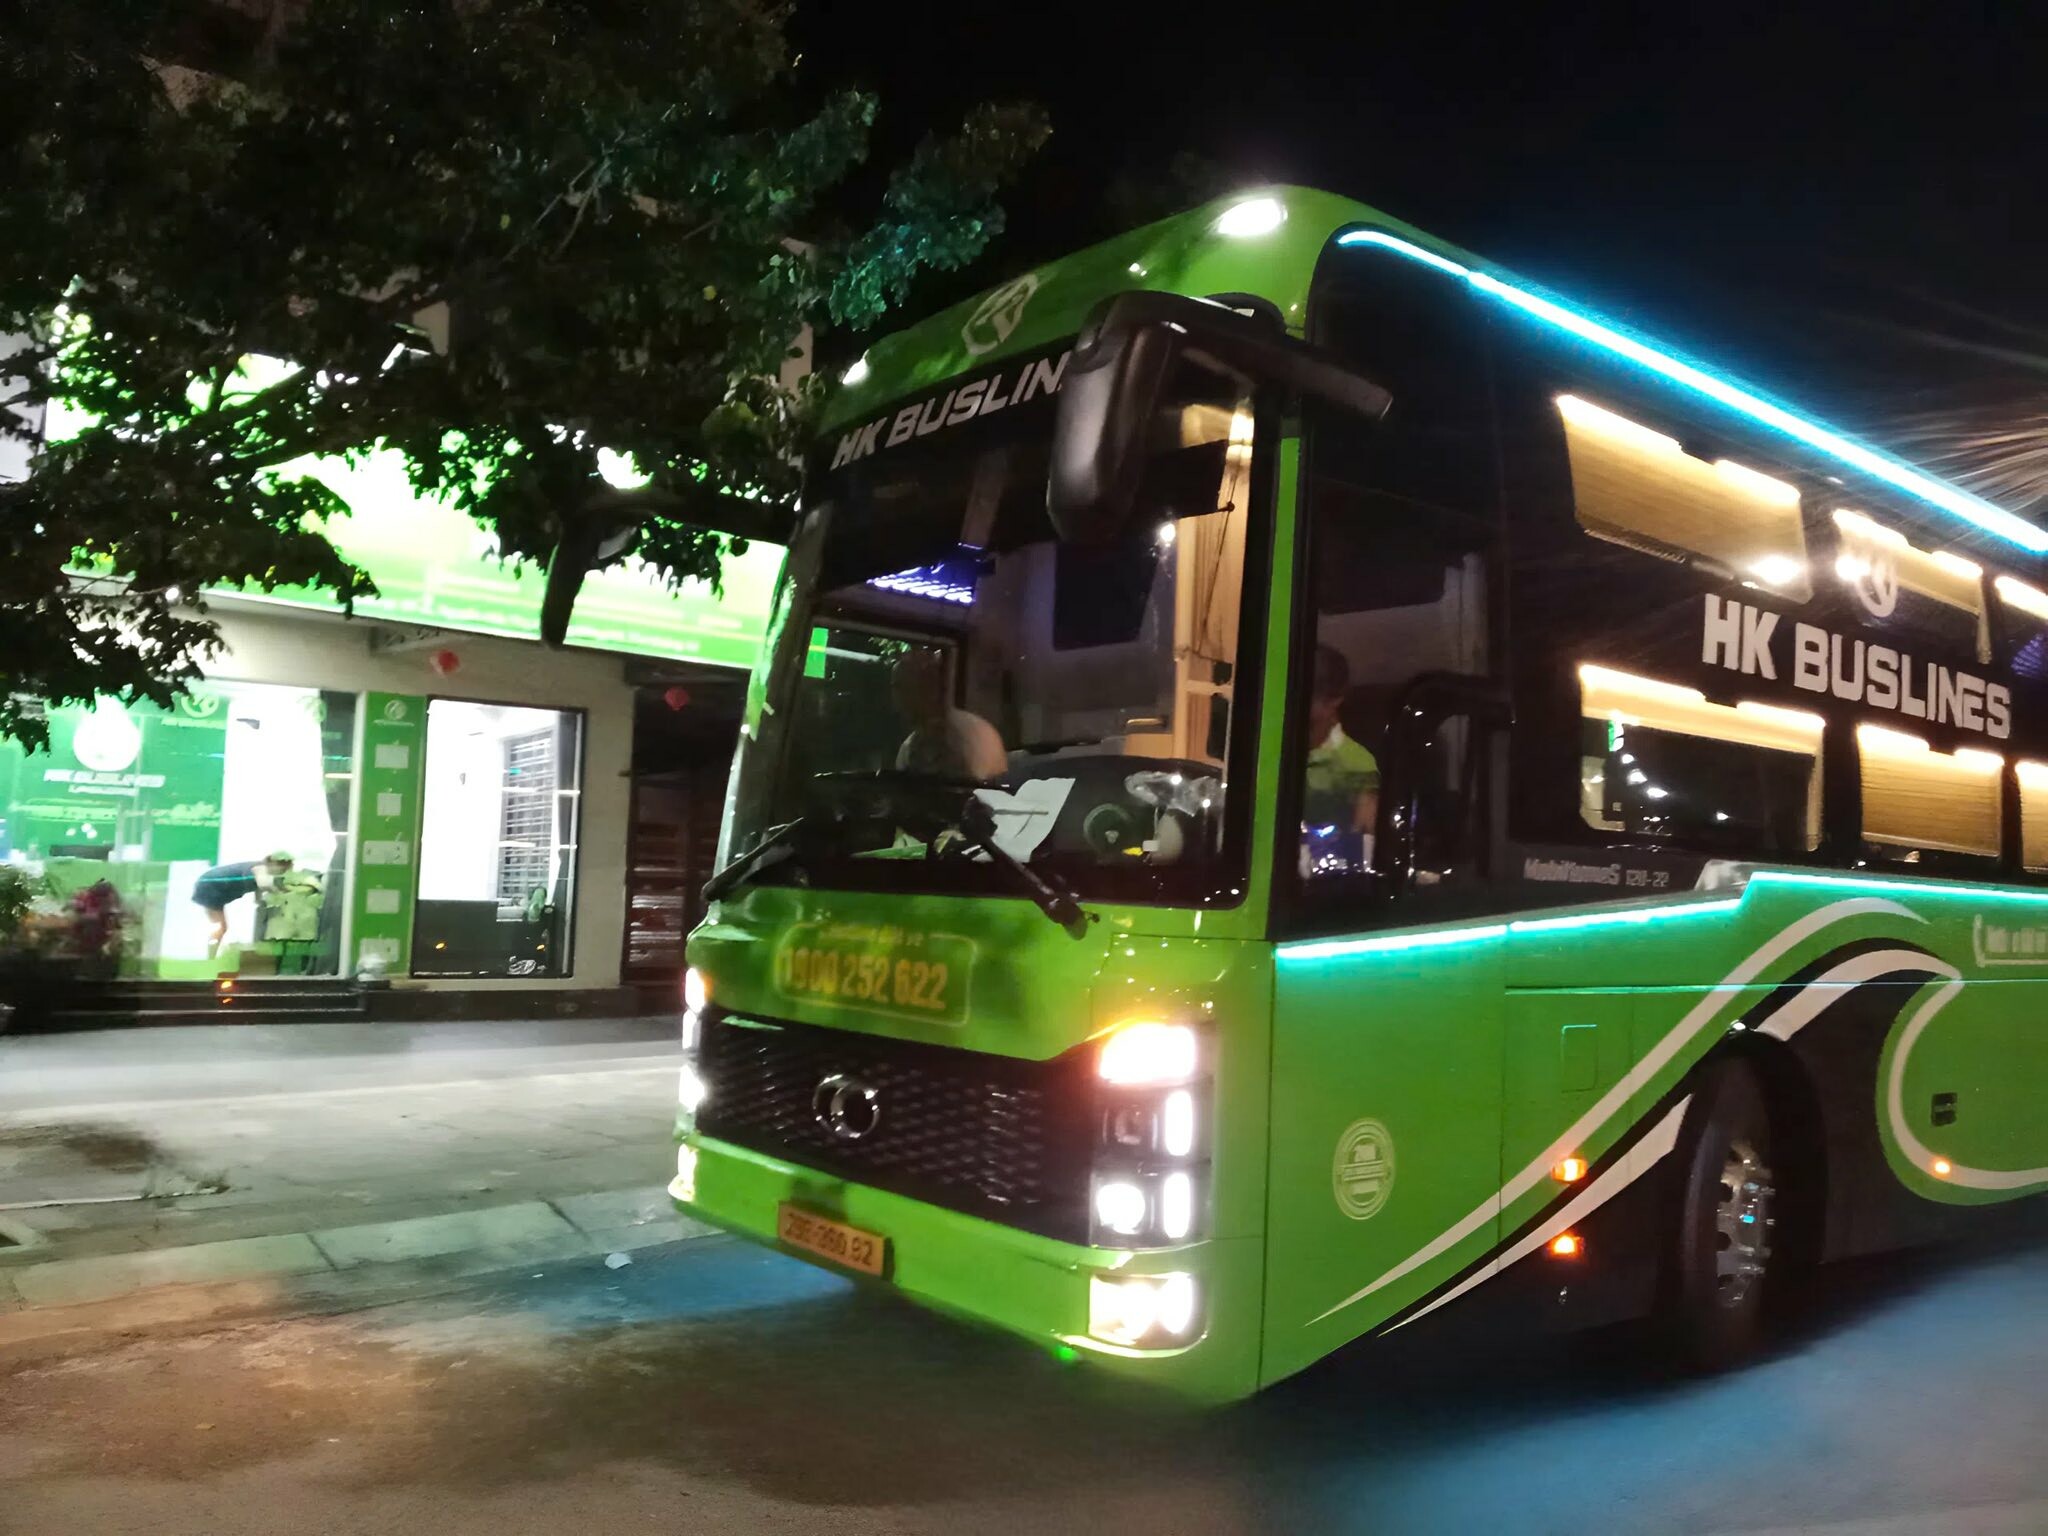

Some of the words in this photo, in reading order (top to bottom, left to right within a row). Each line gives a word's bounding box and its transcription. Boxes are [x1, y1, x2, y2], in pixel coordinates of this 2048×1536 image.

[830, 417, 888, 471] HK
[884, 351, 1071, 448] BUSLIN
[1702, 593, 1781, 680] HK
[1794, 622, 2011, 739] BUSLINES
[841, 953, 890, 1004] 252
[893, 958, 949, 1010] 622
